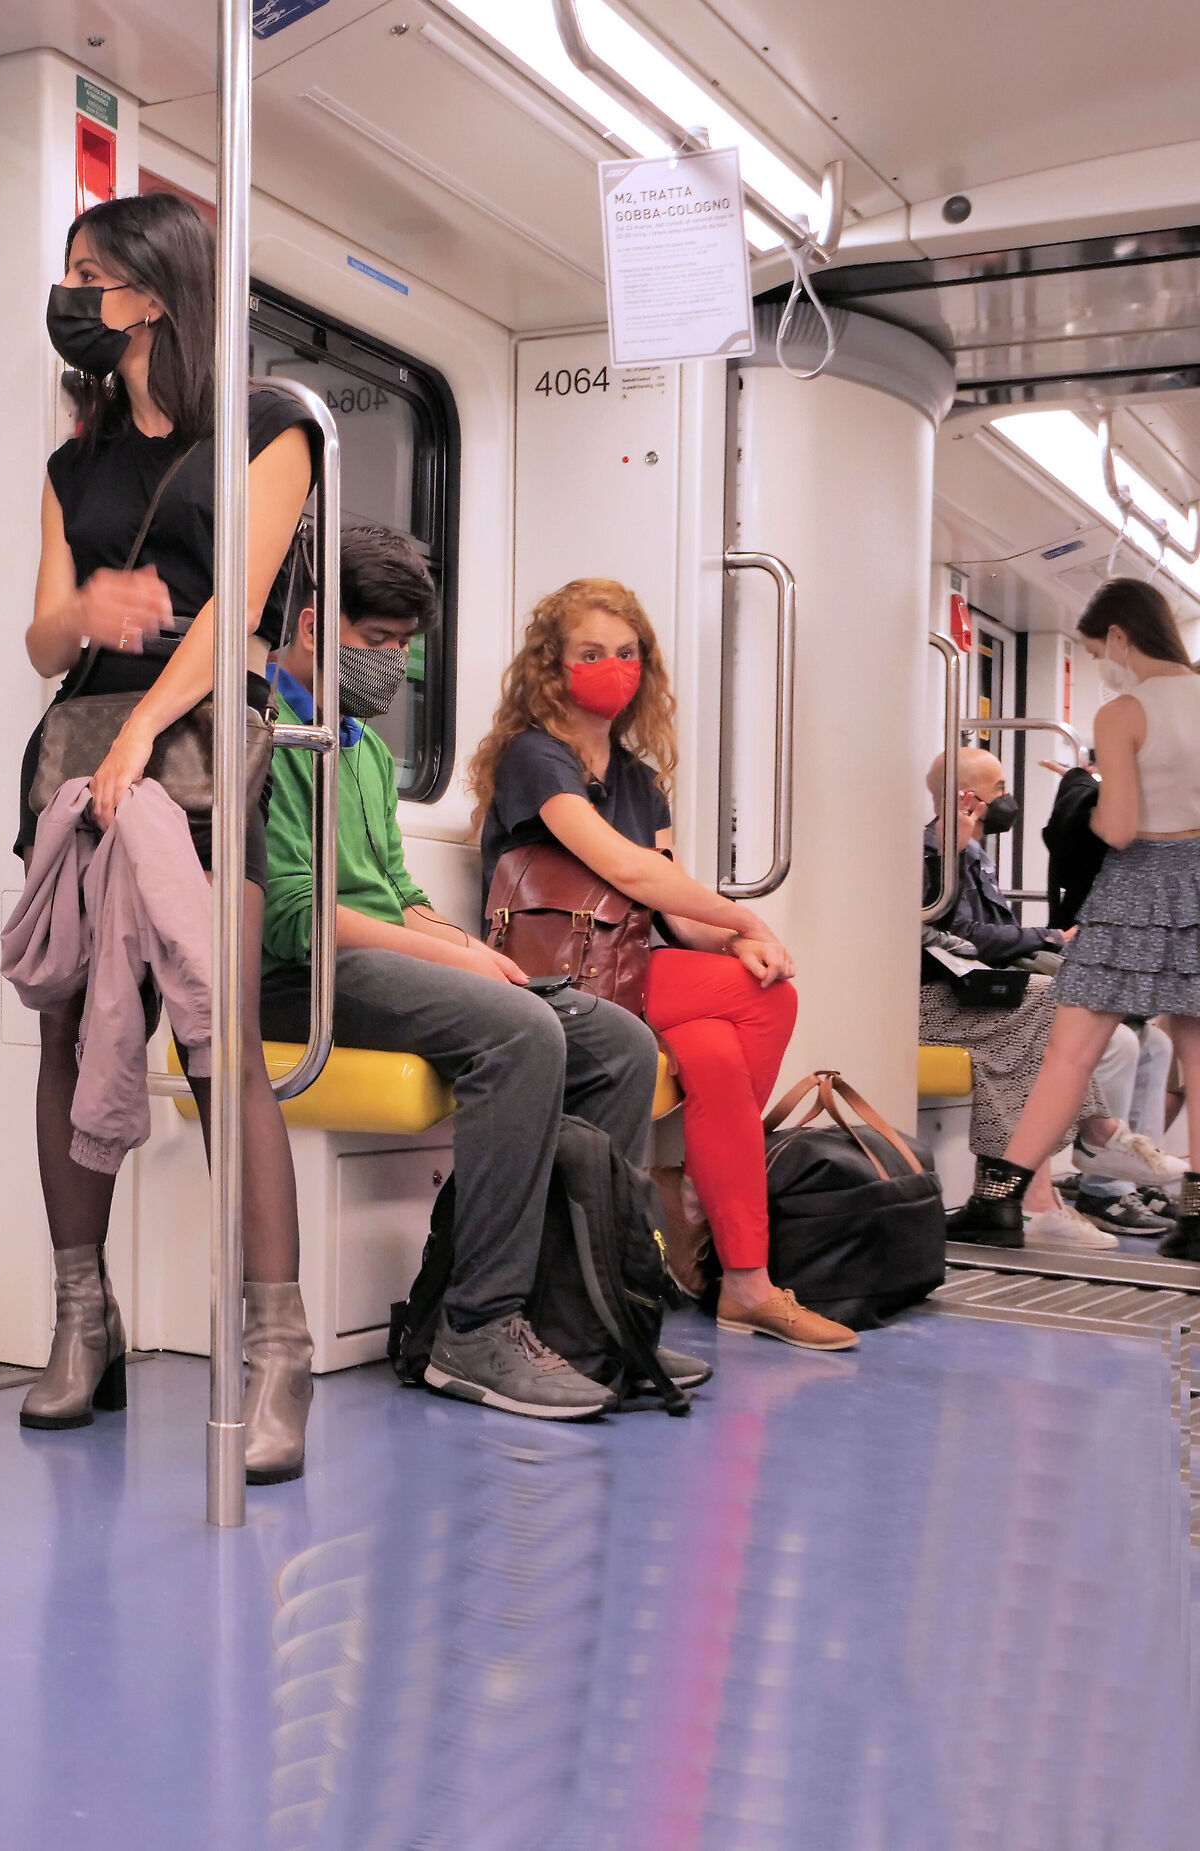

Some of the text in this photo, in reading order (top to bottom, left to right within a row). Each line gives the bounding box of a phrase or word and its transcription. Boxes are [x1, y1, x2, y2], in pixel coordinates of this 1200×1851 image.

[614, 186, 692, 205] M2, TRATTA
[615, 198, 730, 222] GOBBA-COLOGNO
[534, 366, 610, 397] 4064
